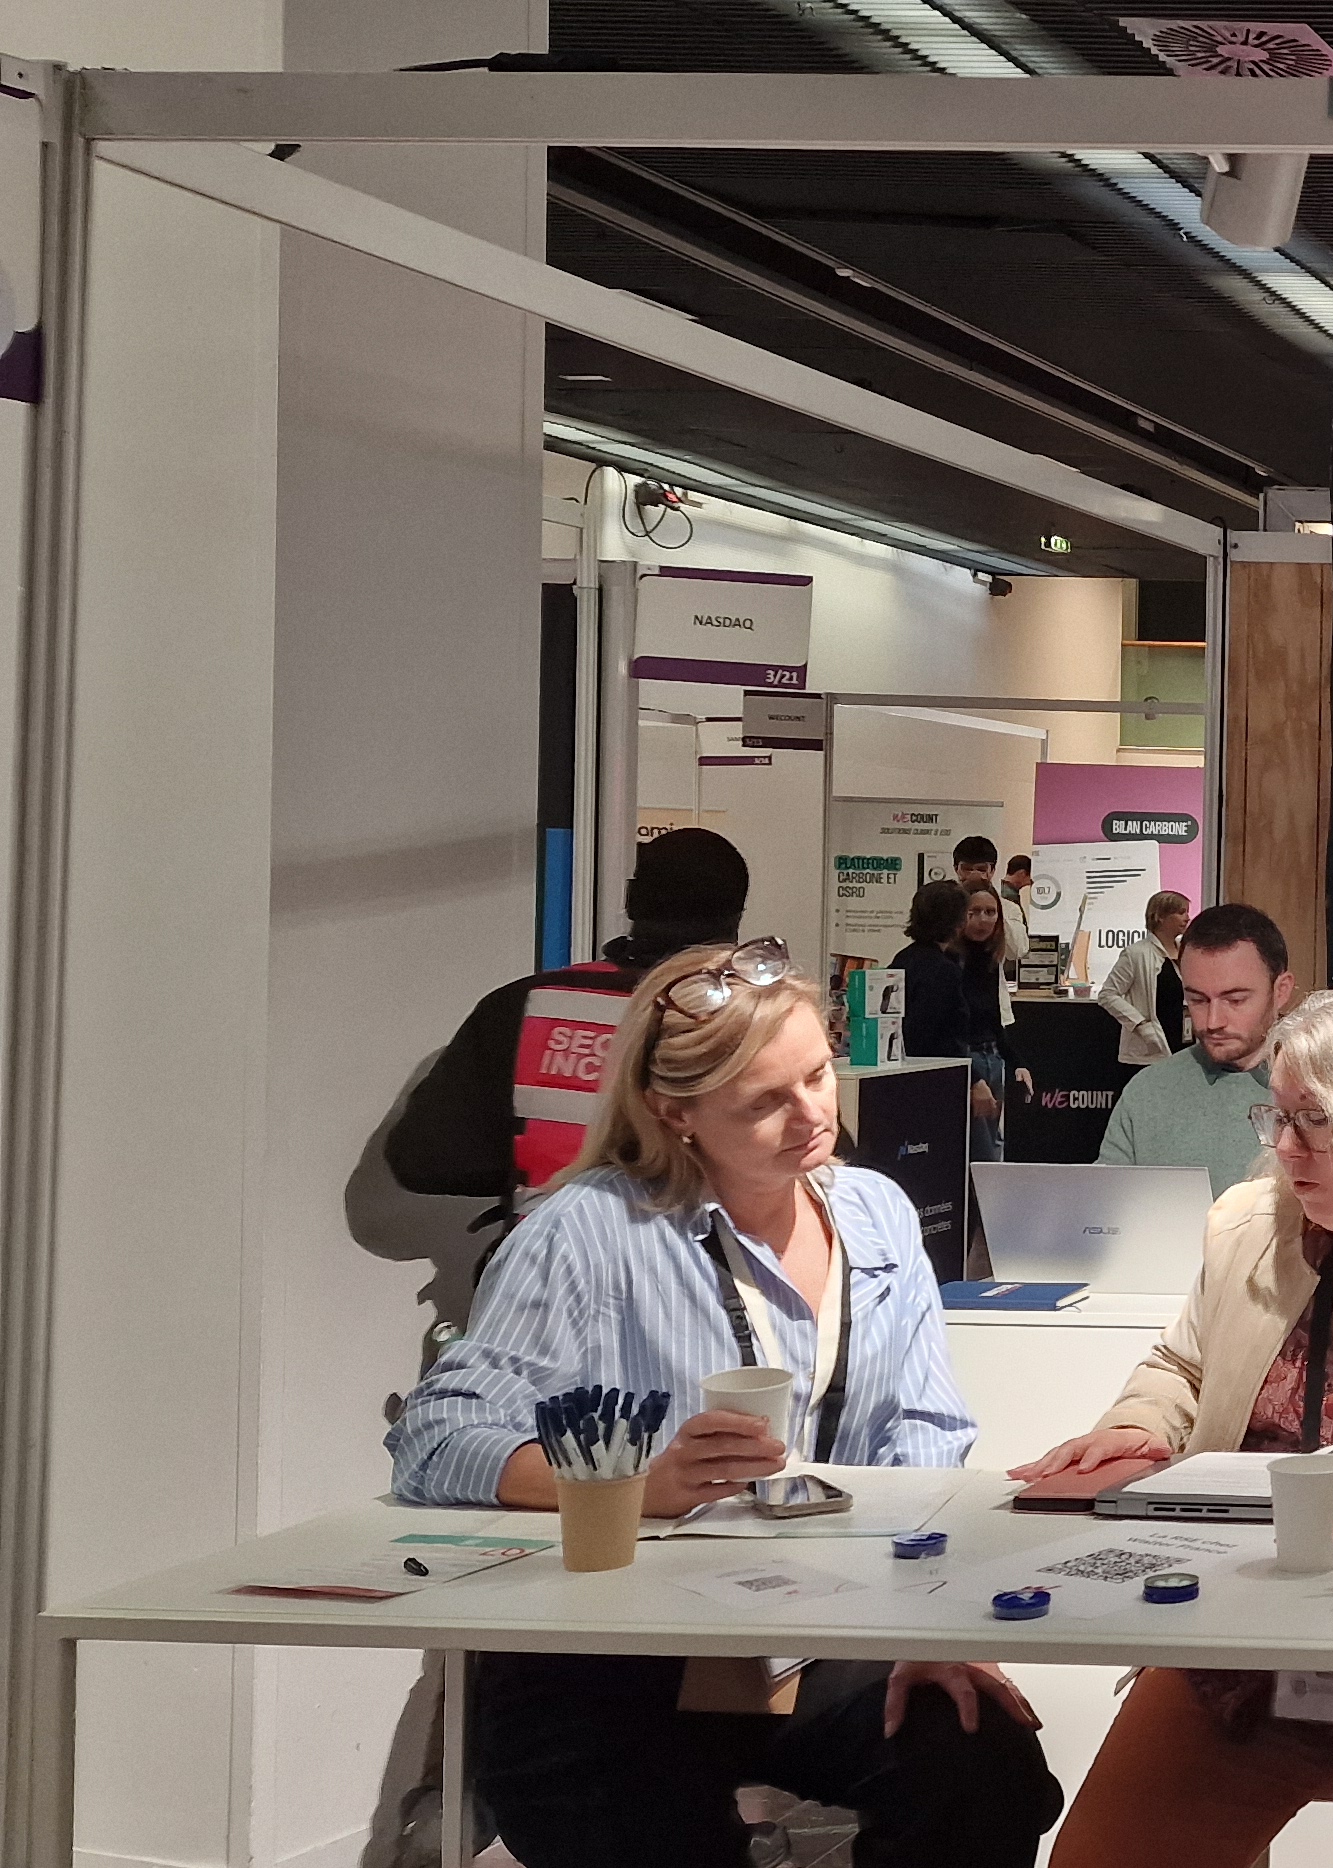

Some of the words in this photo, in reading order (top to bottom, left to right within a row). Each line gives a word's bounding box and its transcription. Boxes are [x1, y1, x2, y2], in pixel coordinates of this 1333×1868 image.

[693, 614, 754, 631] NASDAQ
[765, 669, 799, 685] 3/21
[1112, 819, 1141, 834] BILAN
[837, 856, 900, 870] PLATEFORME
[837, 871, 884, 884] CARBONE
[887, 872, 898, 885] ET
[1083, 1226, 1121, 1235] ASUS
